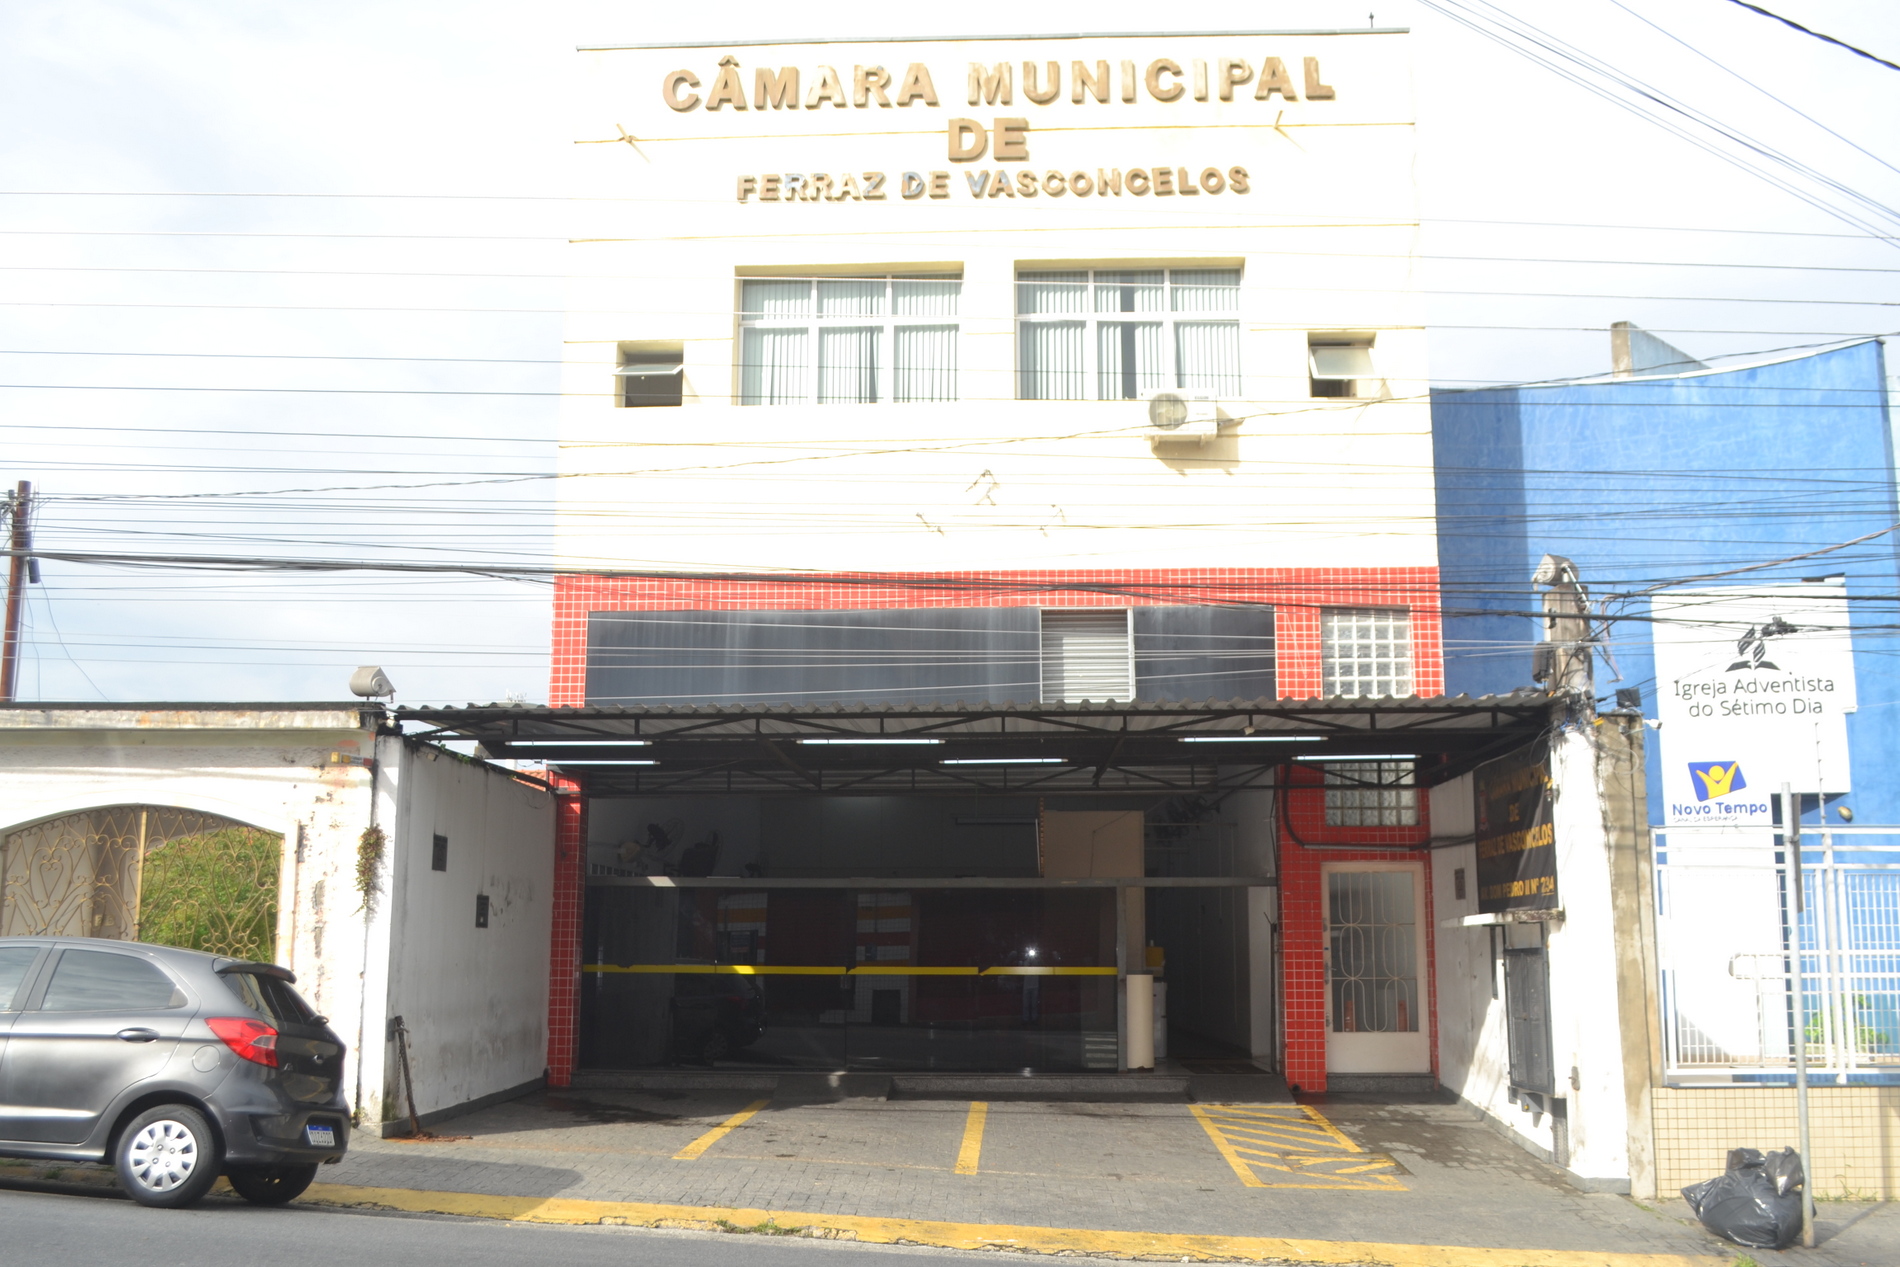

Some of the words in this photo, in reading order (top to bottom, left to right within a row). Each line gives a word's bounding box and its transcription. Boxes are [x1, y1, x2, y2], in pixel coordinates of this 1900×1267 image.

[663, 55, 939, 112] CÂMARA
[968, 56, 1336, 105] MUNICIPAL
[948, 117, 1029, 163] DE
[737, 171, 886, 203] FERRAZ
[901, 170, 950, 199] DE
[966, 165, 1250, 200] VASCONCELOS
[1673, 678, 1727, 700] Igreja
[1733, 677, 1834, 694] Adventista
[1689, 702, 1713, 717] do
[1720, 699, 1787, 716] Sétimo
[1793, 698, 1823, 714] Dia
[1672, 803, 1711, 816] Novo
[1715, 802, 1767, 816] Tempo
[1503, 880, 1524, 897] PEDRO
[1540, 875, 1555, 893] 234
